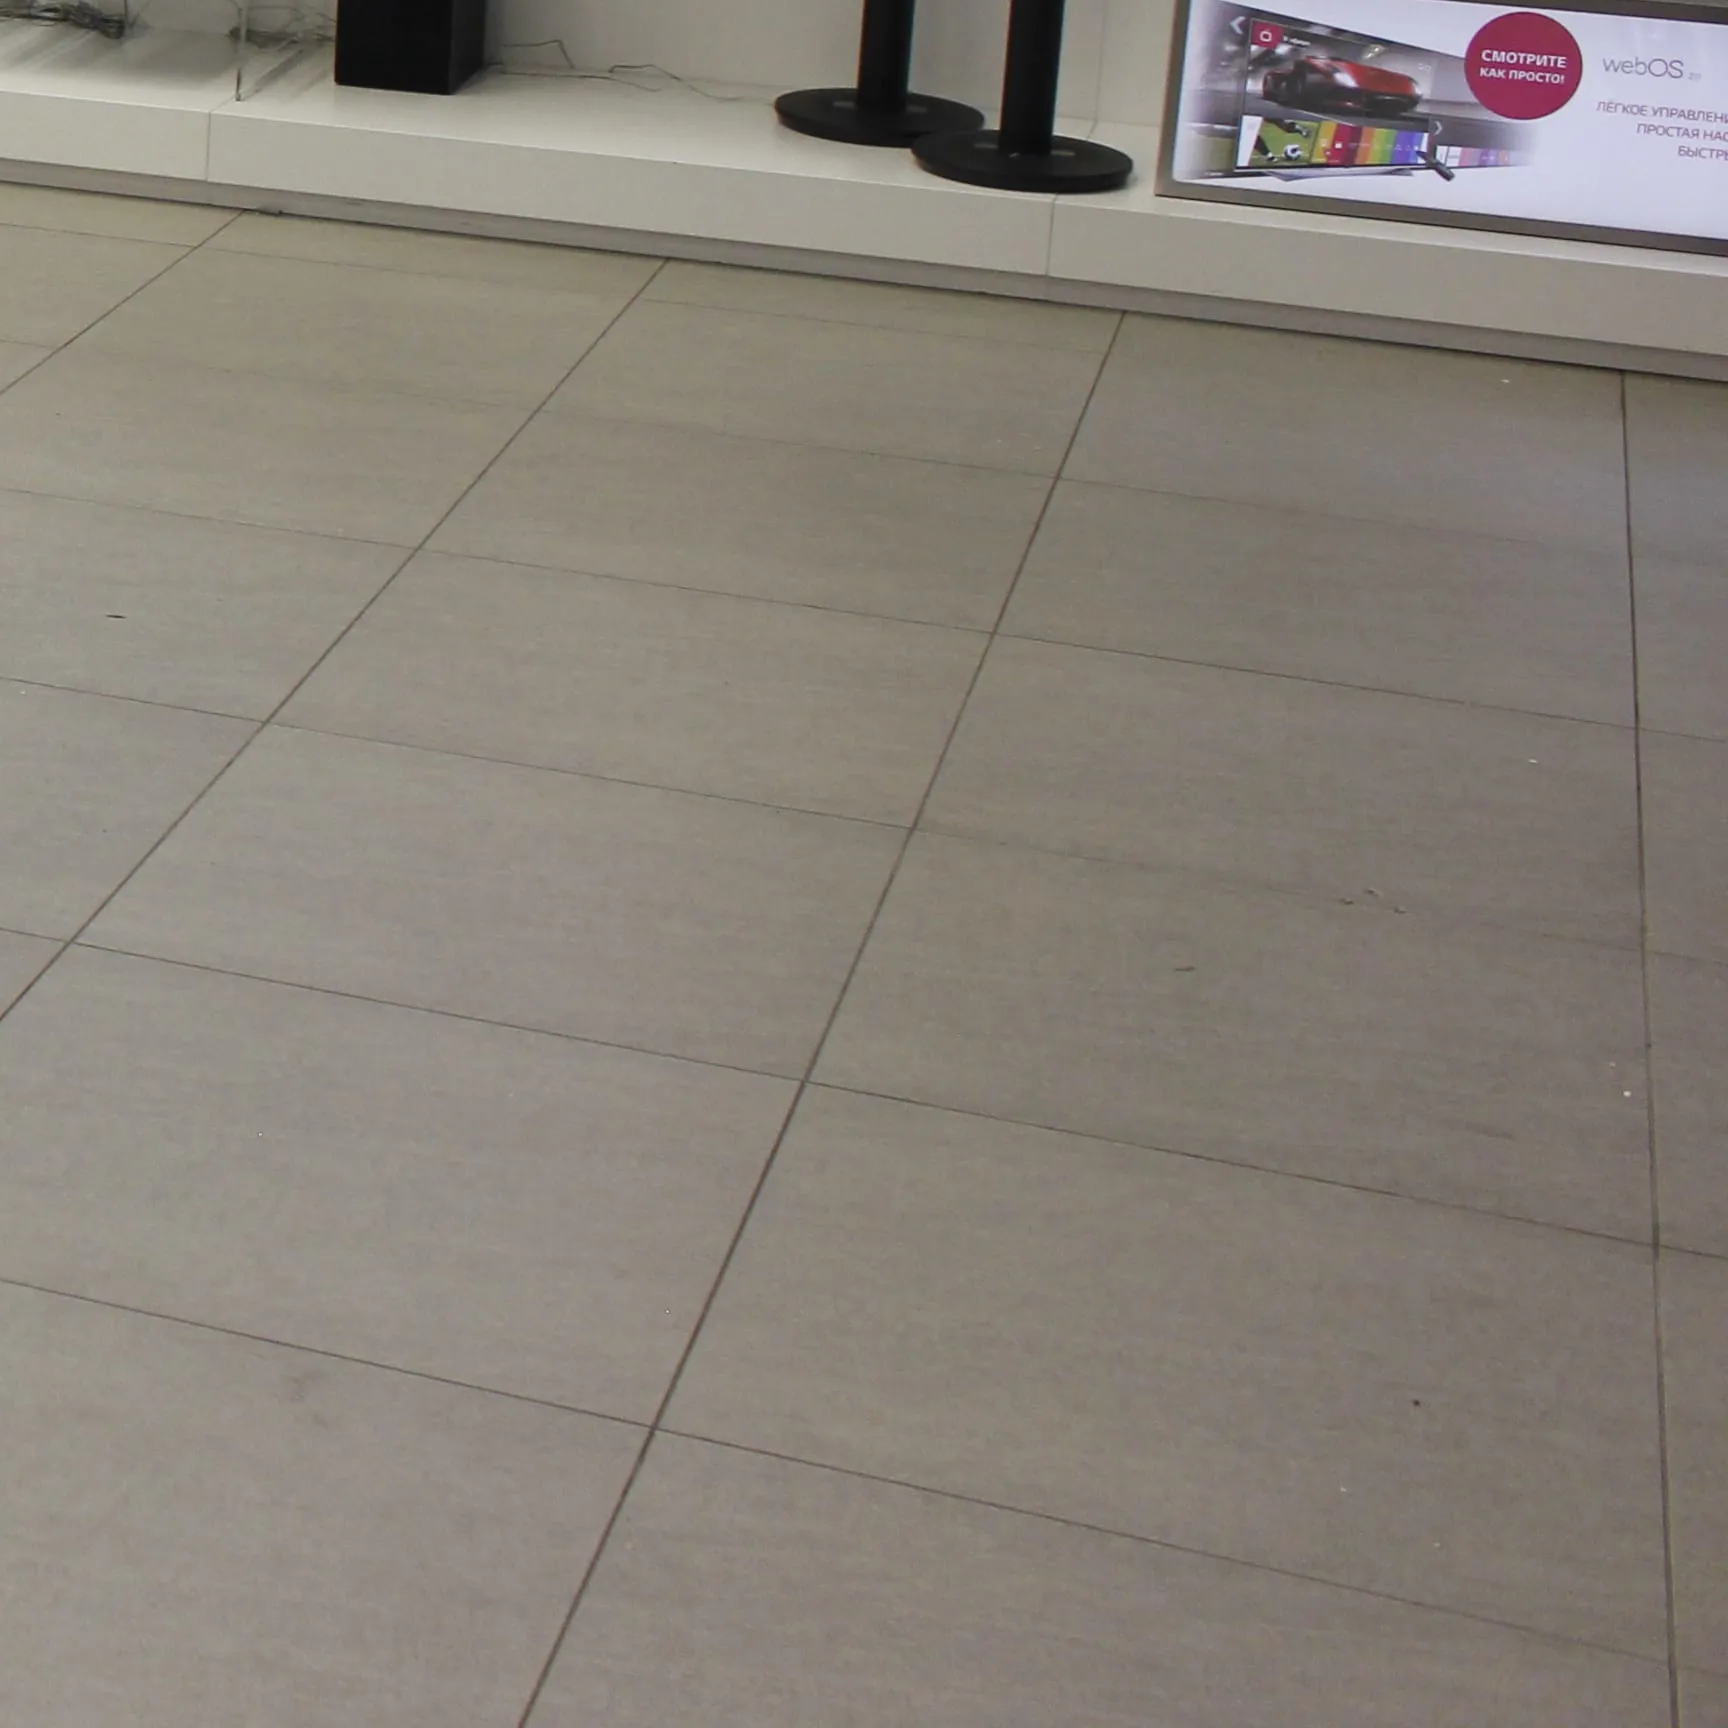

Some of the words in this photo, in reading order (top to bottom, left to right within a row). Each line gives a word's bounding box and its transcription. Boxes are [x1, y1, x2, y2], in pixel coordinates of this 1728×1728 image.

[1481, 49, 1567, 68] СМОТРИТЕ
[1479, 67, 1506, 79] КАК
[1508, 69, 1565, 84] ПРОСТО!
[1602, 57, 1684, 79] webOS
[1636, 123, 1700, 140] ПРОСТАЯ
